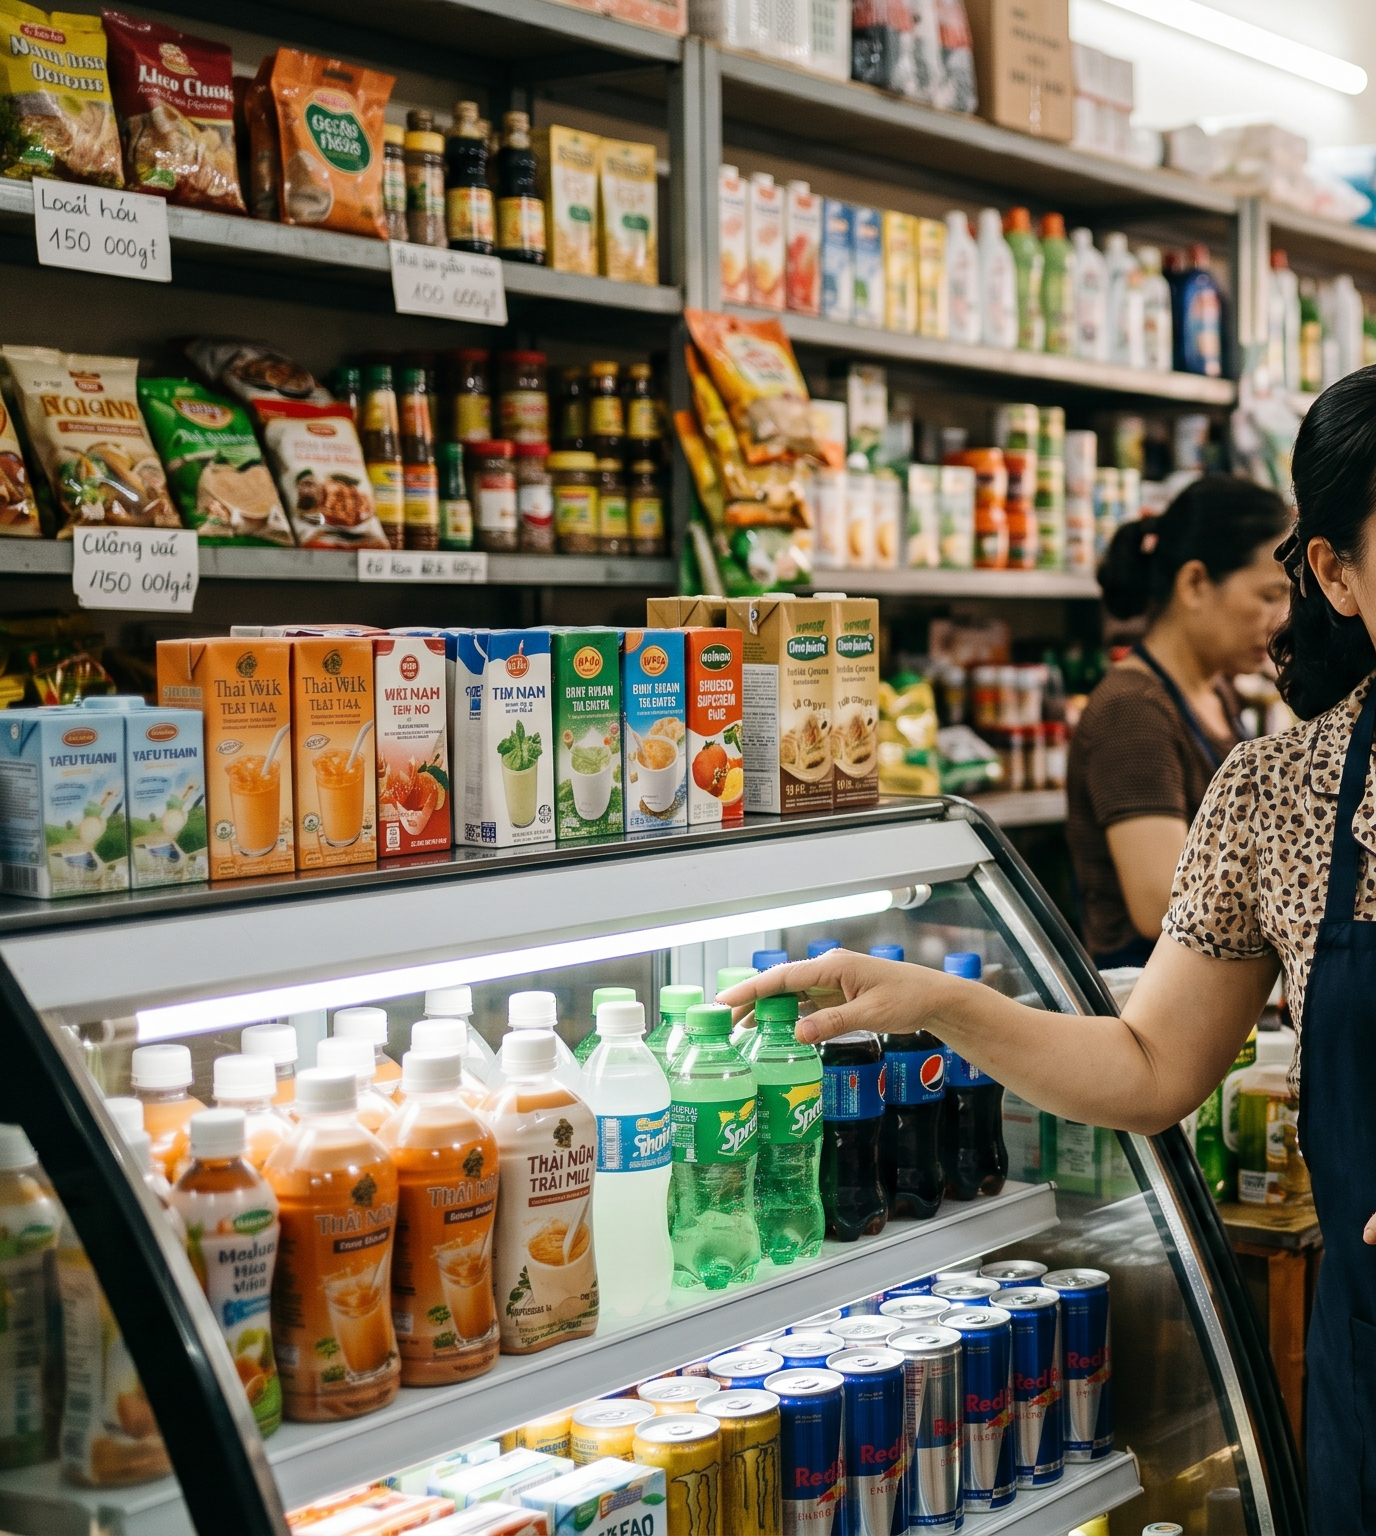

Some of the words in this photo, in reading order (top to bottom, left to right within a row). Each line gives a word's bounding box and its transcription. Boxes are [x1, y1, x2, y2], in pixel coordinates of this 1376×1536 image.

[49, 227, 91, 253] 150
[722, 1108, 758, 1152] Spri
[791, 1095, 823, 1132] Spri
